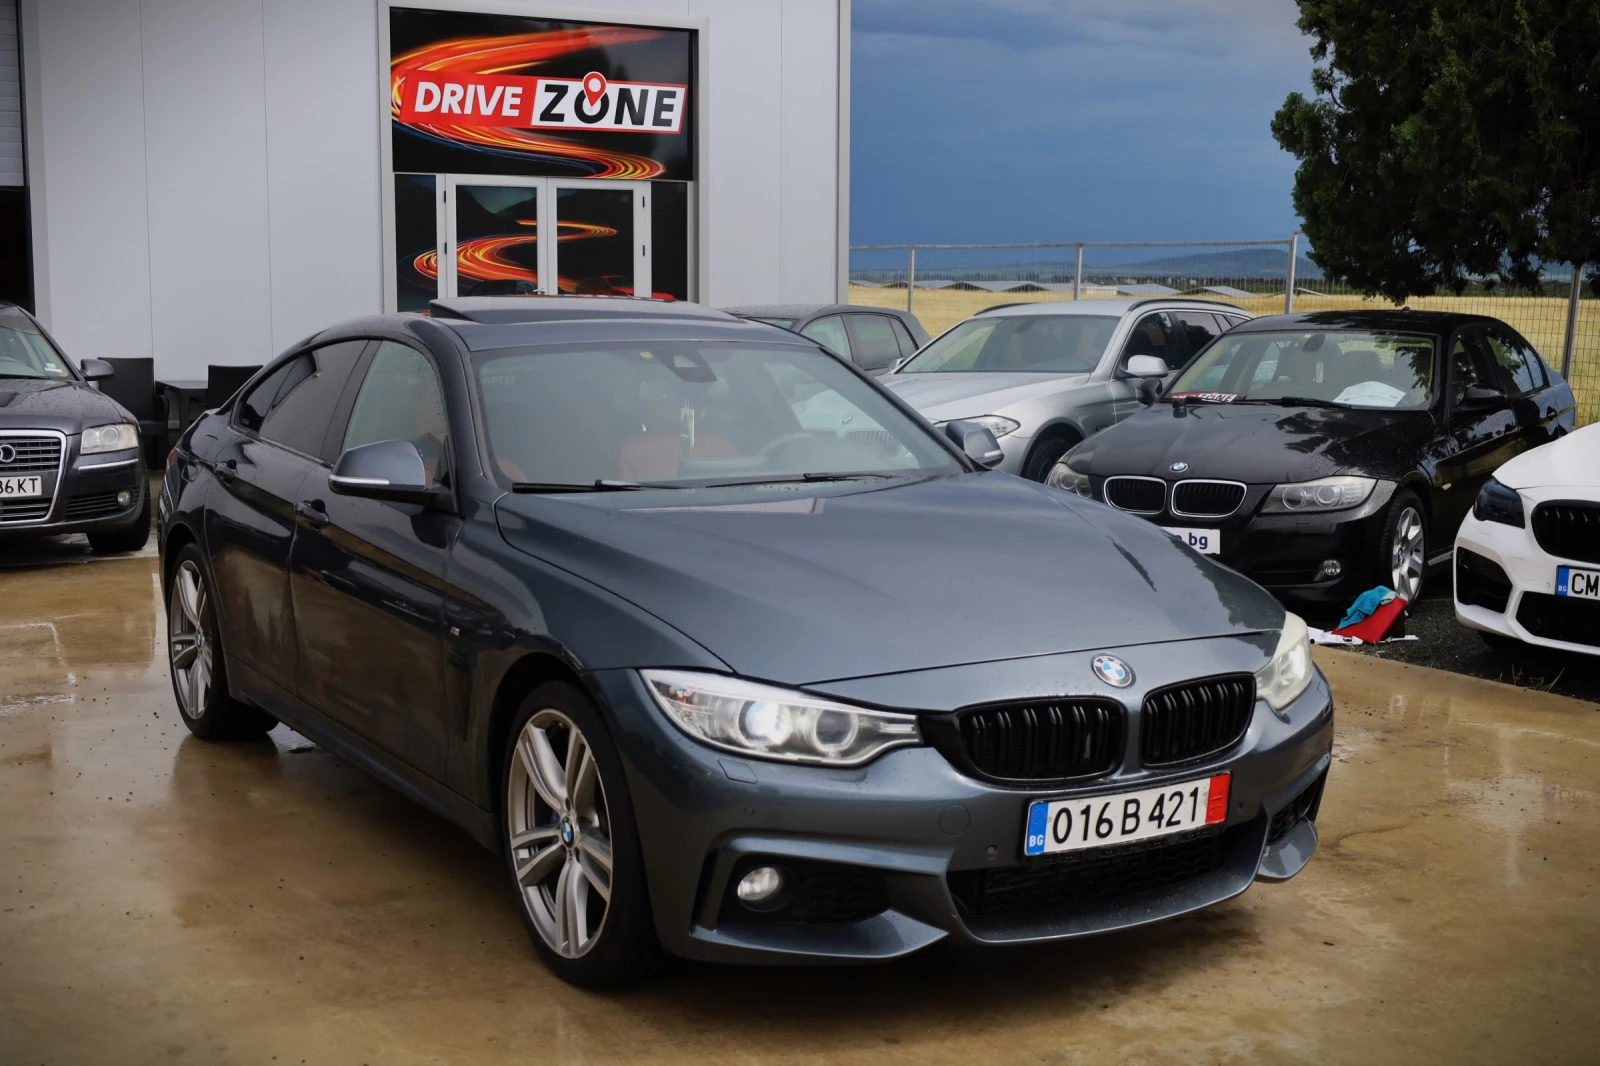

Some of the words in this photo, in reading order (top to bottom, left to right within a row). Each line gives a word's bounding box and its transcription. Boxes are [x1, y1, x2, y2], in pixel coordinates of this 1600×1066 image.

[413, 81, 524, 117] DRIVE
[538, 82, 677, 128] ZONE
[1571, 572, 1600, 597] CM
[1029, 834, 1044, 847] BG
